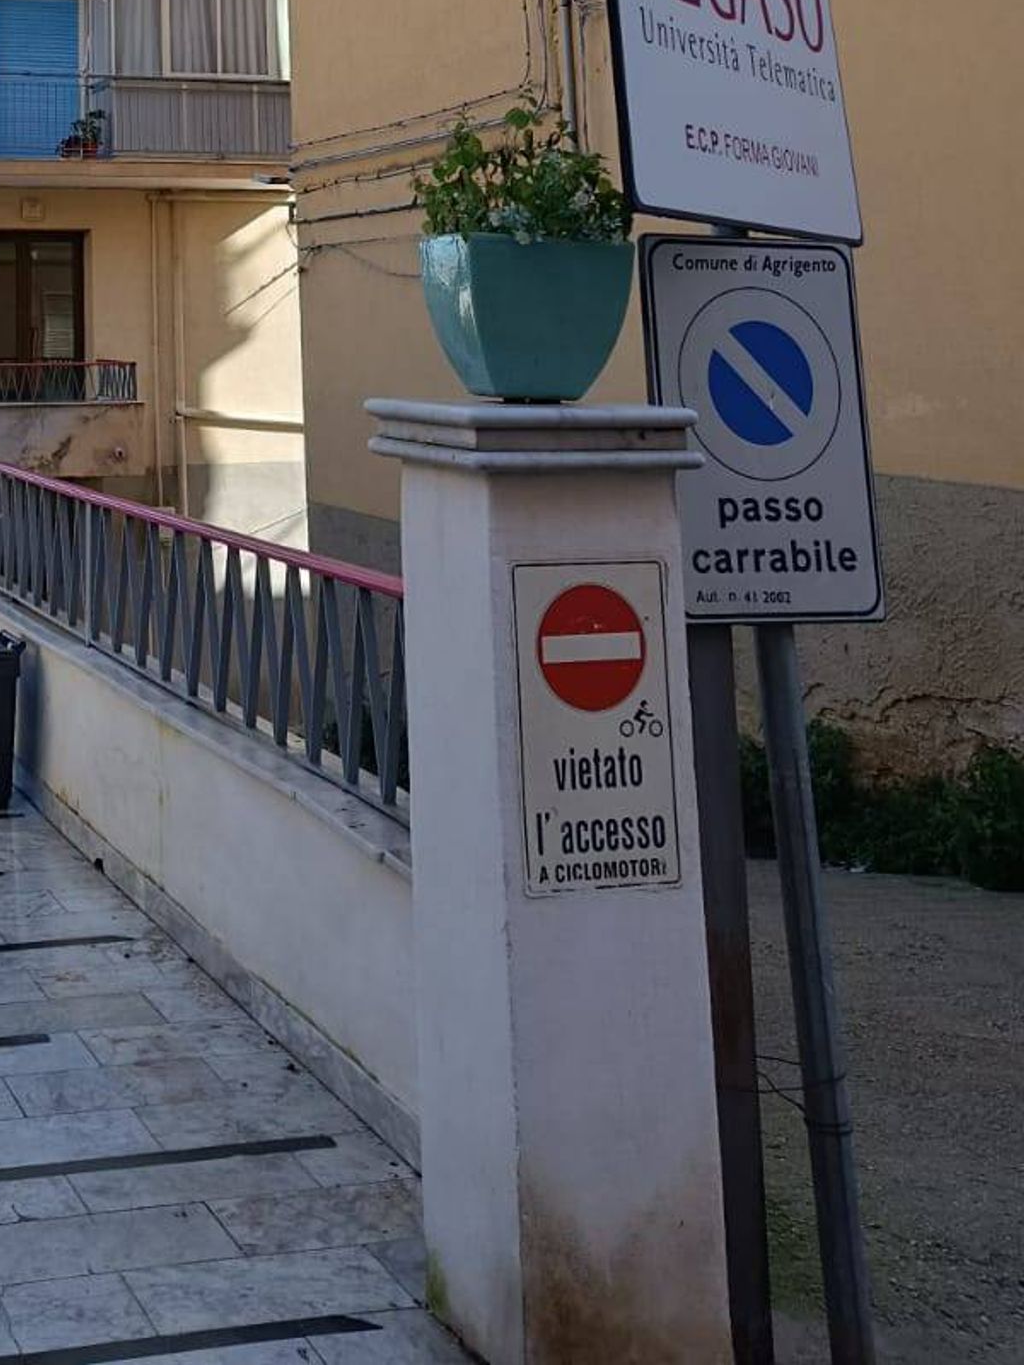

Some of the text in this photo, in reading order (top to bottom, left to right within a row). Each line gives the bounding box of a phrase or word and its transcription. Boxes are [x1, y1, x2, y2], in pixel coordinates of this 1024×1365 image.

[639, 6, 836, 102] Università Telematica
[672, 253, 836, 277] Comune di Agrigento
[718, 497, 824, 529] passo
[691, 540, 858, 574] carrabile
[553, 746, 643, 791] vietato
[539, 865, 550, 884] A
